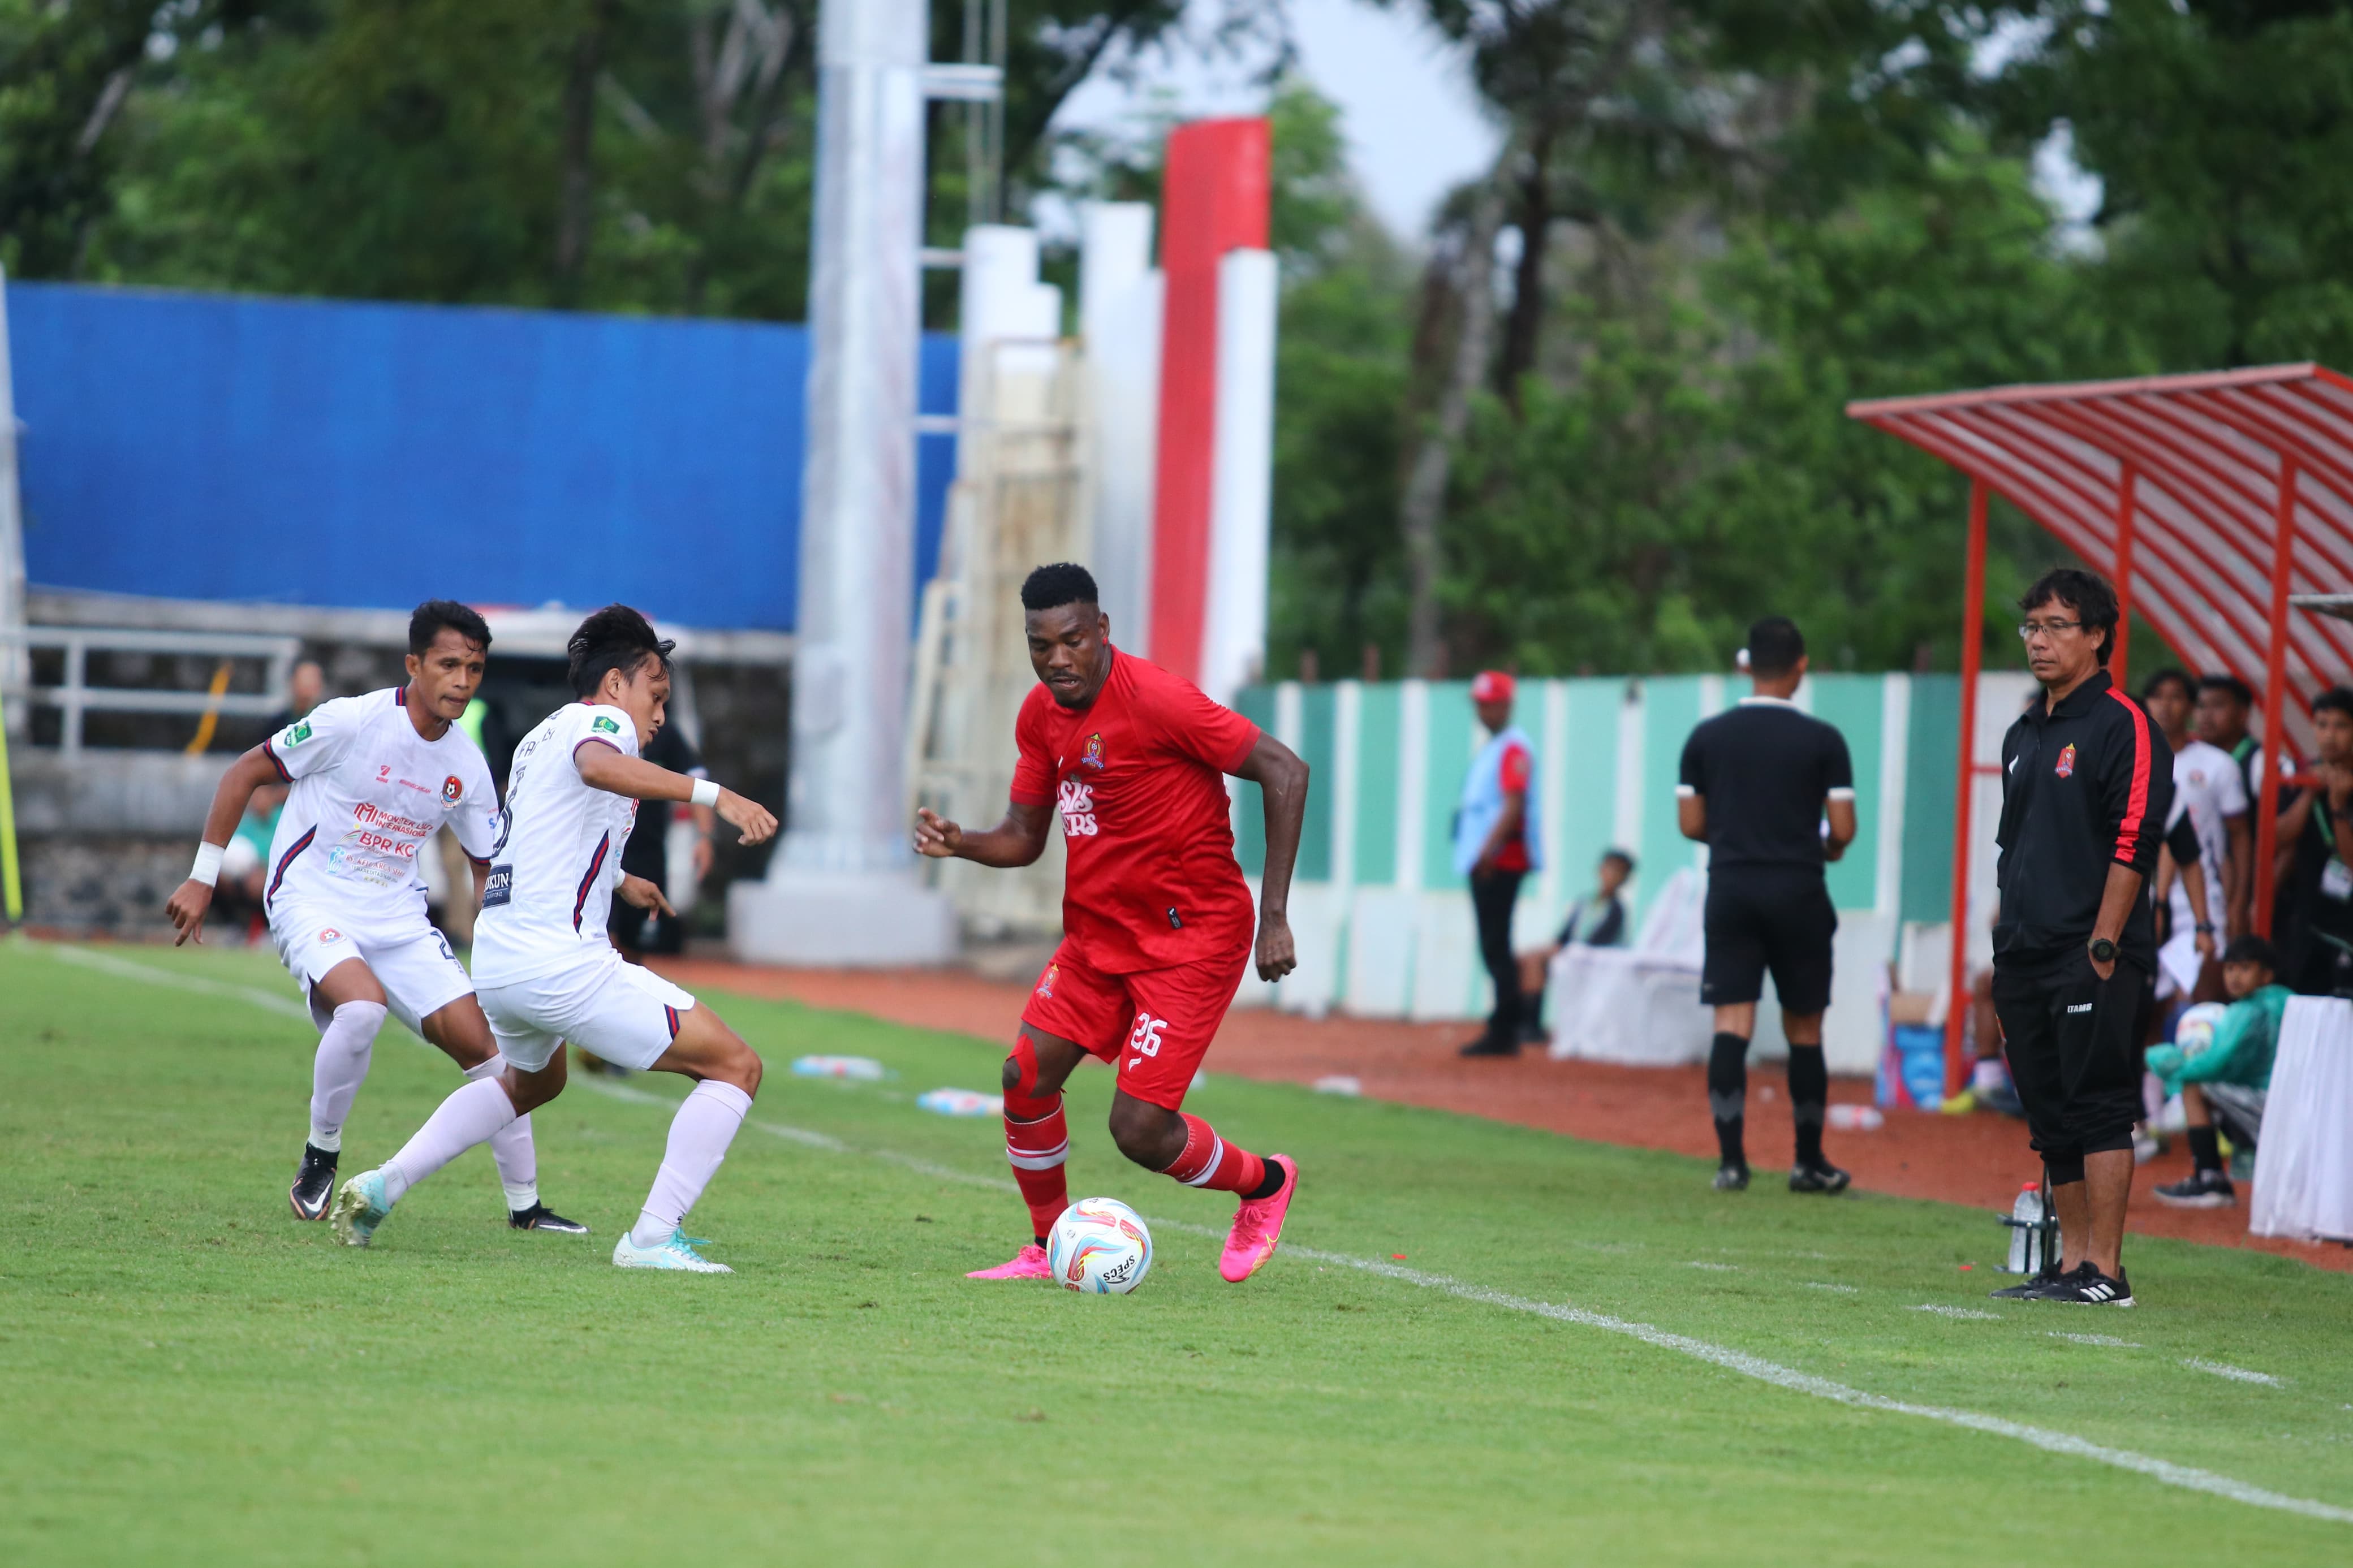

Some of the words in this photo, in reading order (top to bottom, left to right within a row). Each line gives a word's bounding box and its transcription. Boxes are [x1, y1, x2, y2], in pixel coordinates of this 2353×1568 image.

[1057, 780, 1093, 814] SIS
[359, 831, 393, 852] BPR
[394, 841, 415, 858] KC
[484, 872, 509, 892] UKUN
[1131, 1012, 1168, 1057] 26
[1103, 1255, 1135, 1281] SPECS
